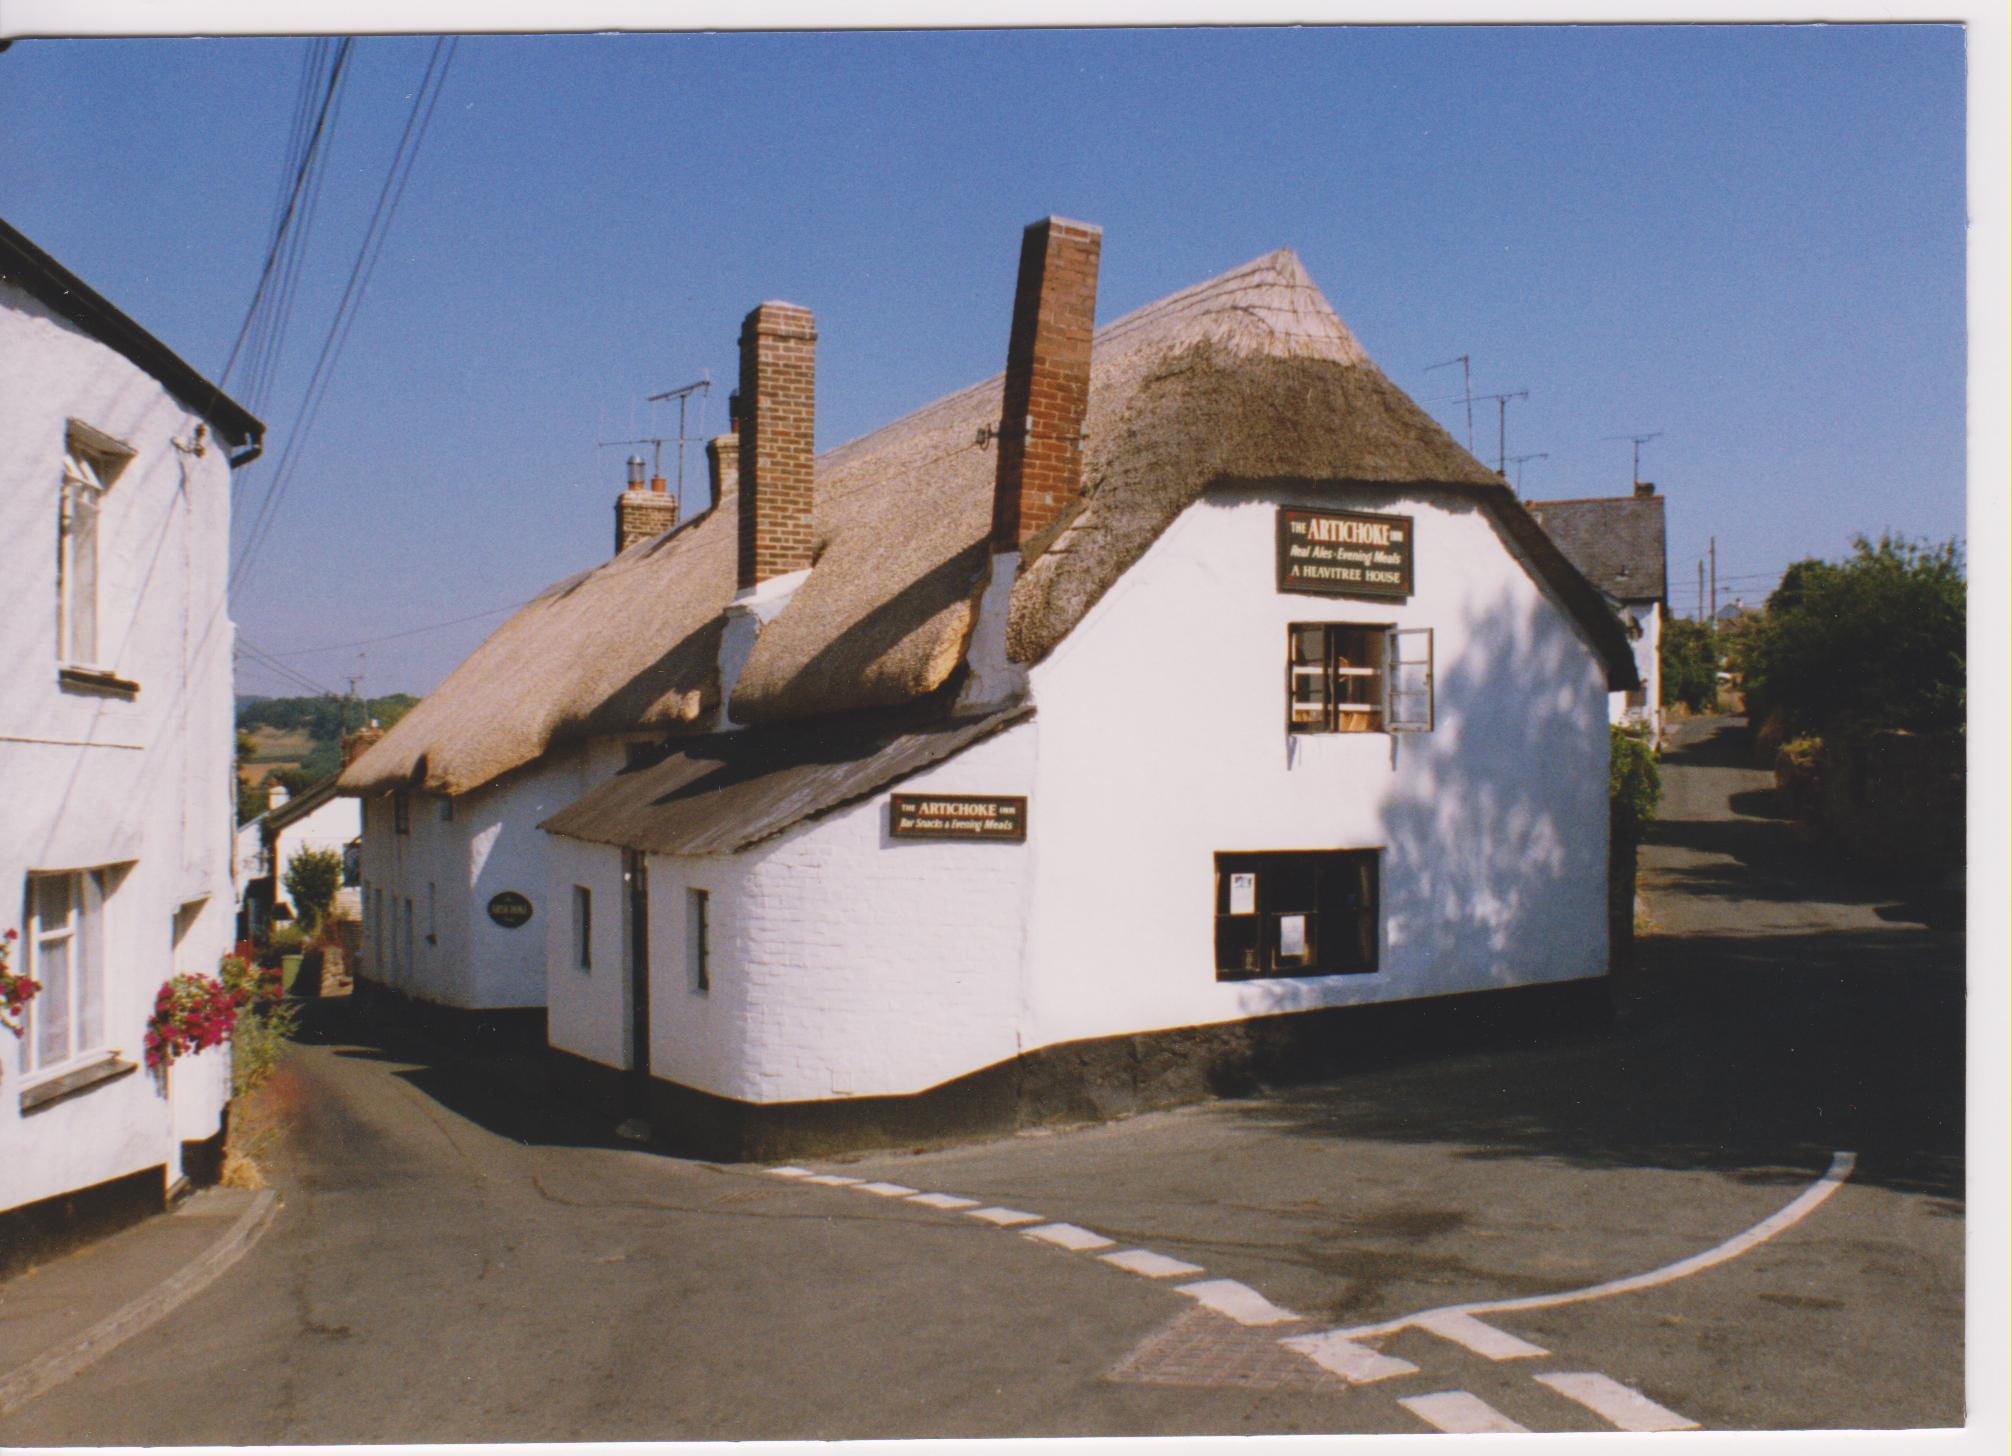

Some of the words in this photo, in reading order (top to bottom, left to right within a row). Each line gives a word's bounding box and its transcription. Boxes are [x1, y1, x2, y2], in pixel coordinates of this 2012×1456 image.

[1290, 521, 1306, 534] THE
[1307, 518, 1391, 546] ARTICHOKE
[1373, 550, 1402, 565] Meals
[1291, 564, 1300, 577] A
[1302, 565, 1362, 581] HEAVITREE
[1365, 570, 1401, 583] HOUSE
[918, 802, 997, 816] ARTICHOKE
[983, 819, 1013, 831] Meals
